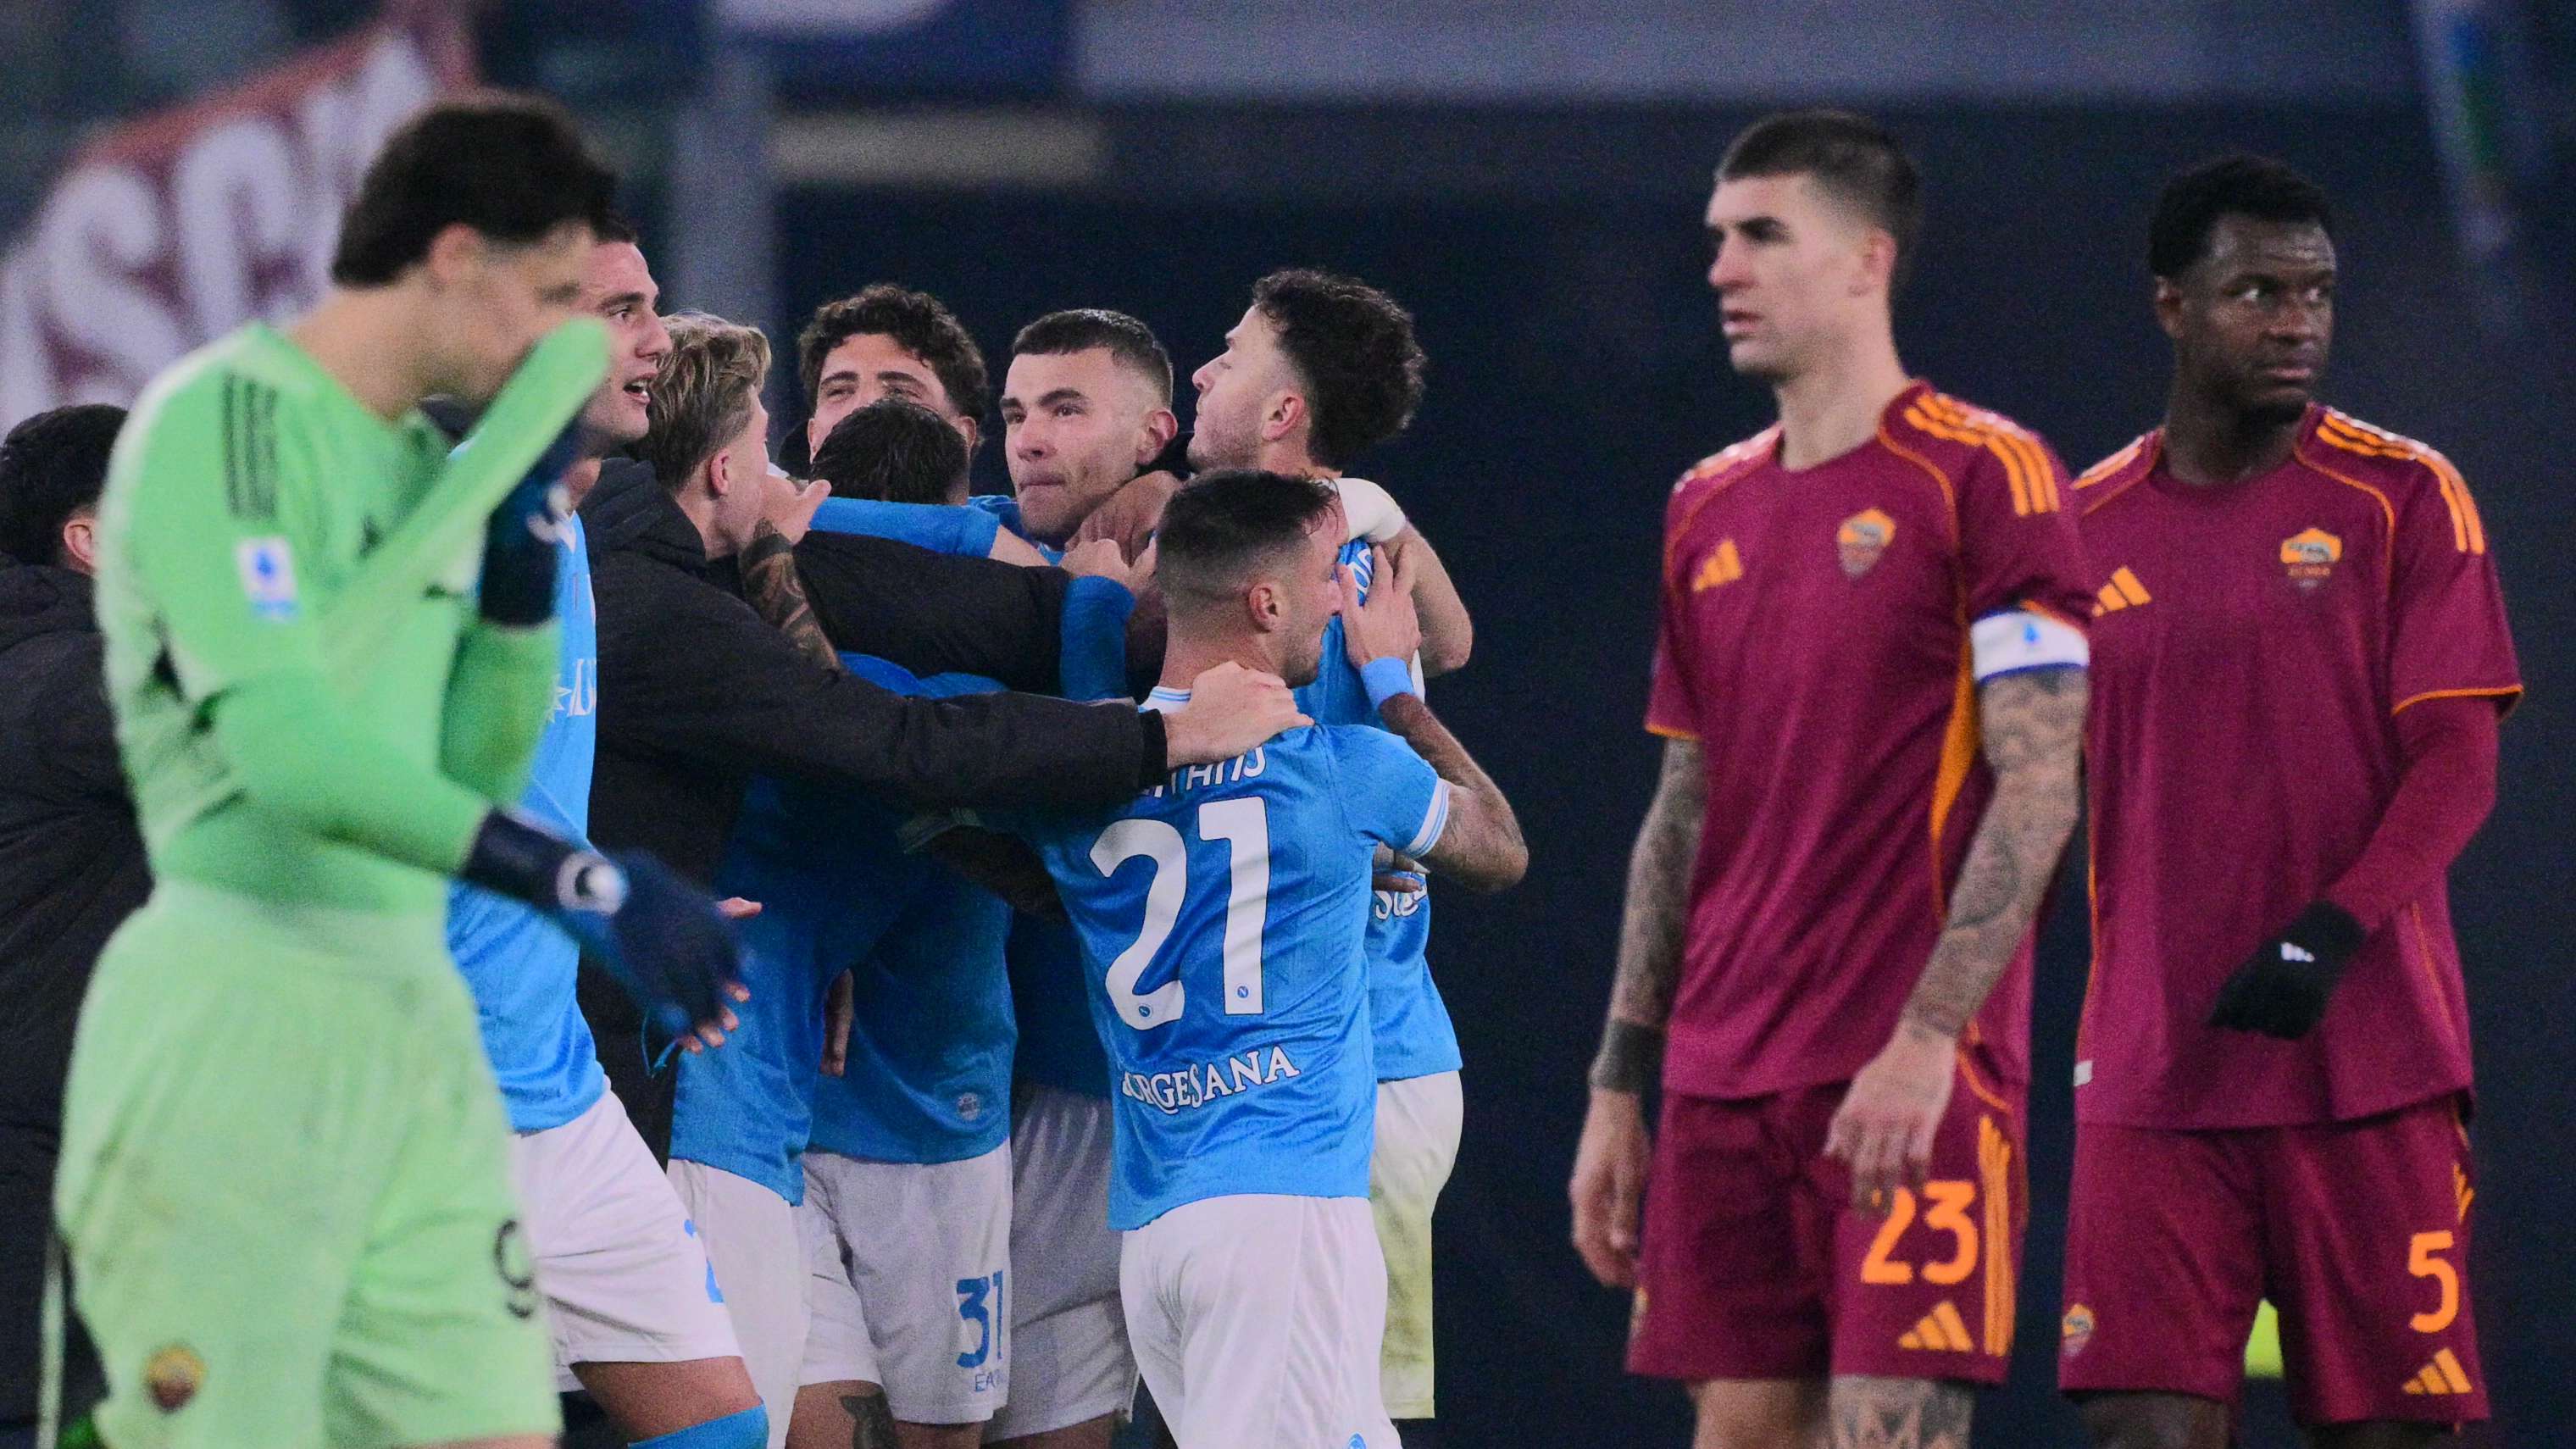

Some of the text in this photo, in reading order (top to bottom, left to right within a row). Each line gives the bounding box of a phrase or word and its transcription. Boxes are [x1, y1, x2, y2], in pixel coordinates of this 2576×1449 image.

[1090, 797, 1270, 1030] 21
[1861, 1180, 1979, 1285] 23
[2408, 1230, 2459, 1333] 5
[956, 1270, 1003, 1369] 31
